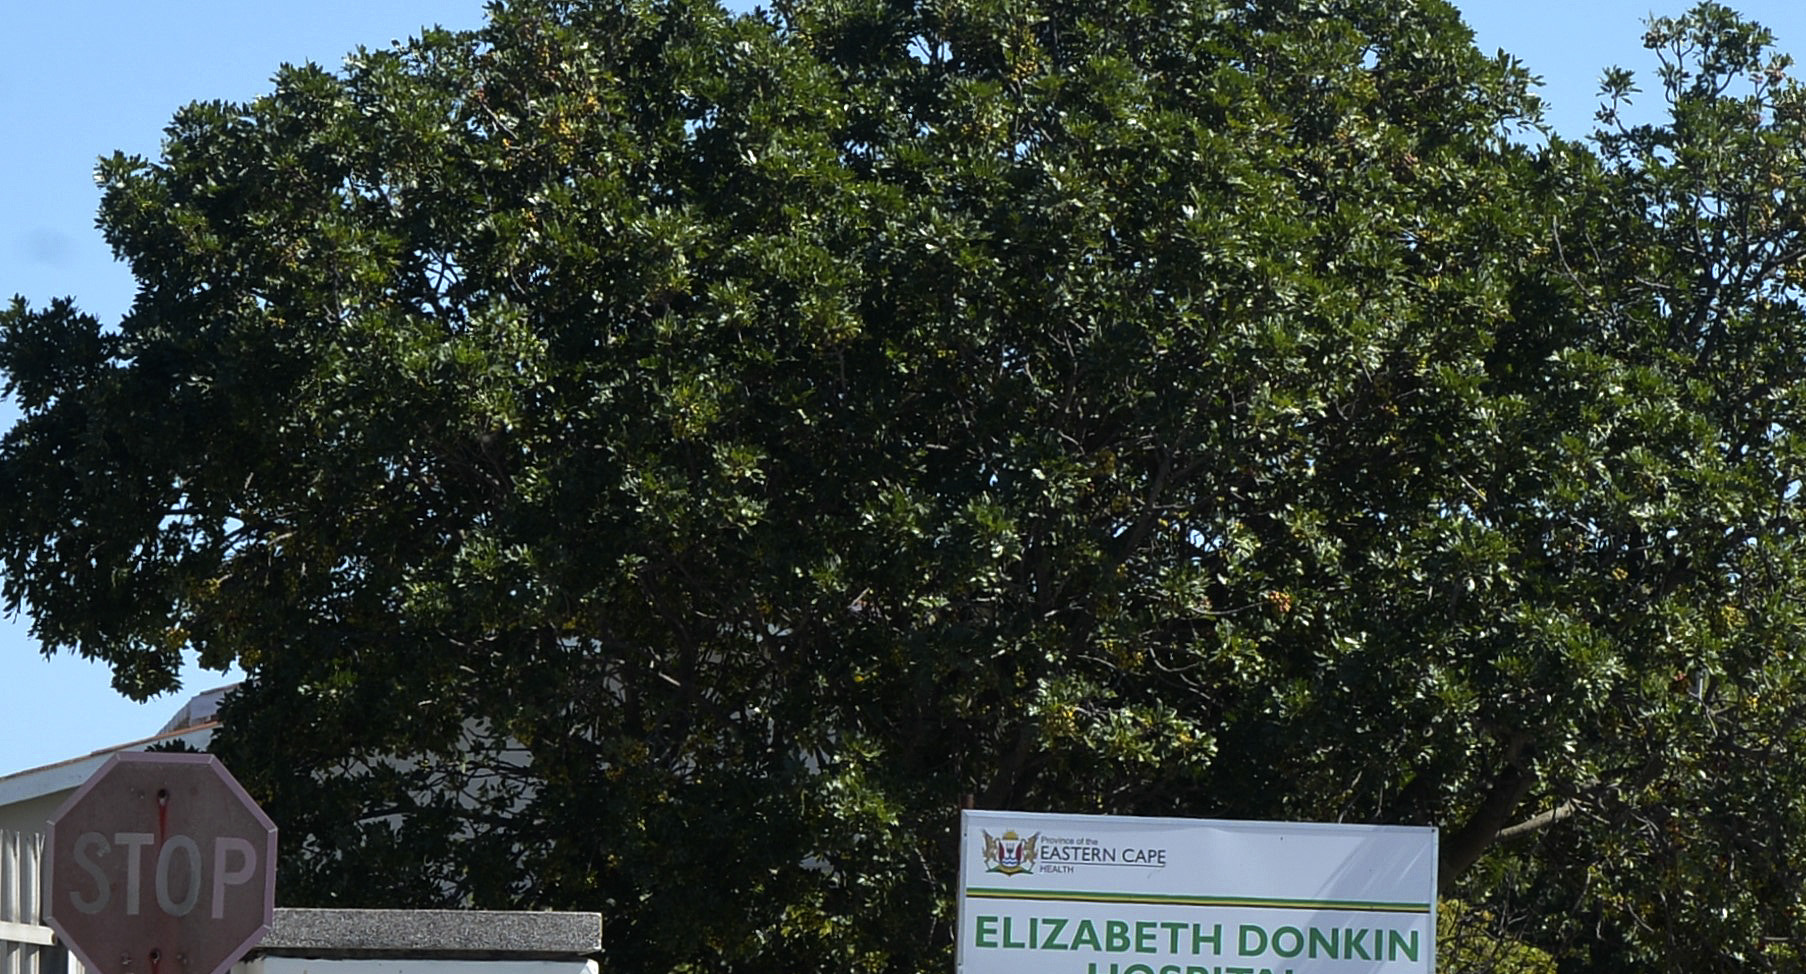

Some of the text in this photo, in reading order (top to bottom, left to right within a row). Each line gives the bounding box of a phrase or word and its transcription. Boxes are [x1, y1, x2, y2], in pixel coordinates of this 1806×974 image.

[1041, 836, 1098, 846] Province of the
[1040, 845, 1166, 865] EASTERN CAPE
[68, 831, 257, 919] STOP
[1040, 865, 1074, 874] HEALTH
[975, 915, 1420, 962] ELIZABETH DONKIN
